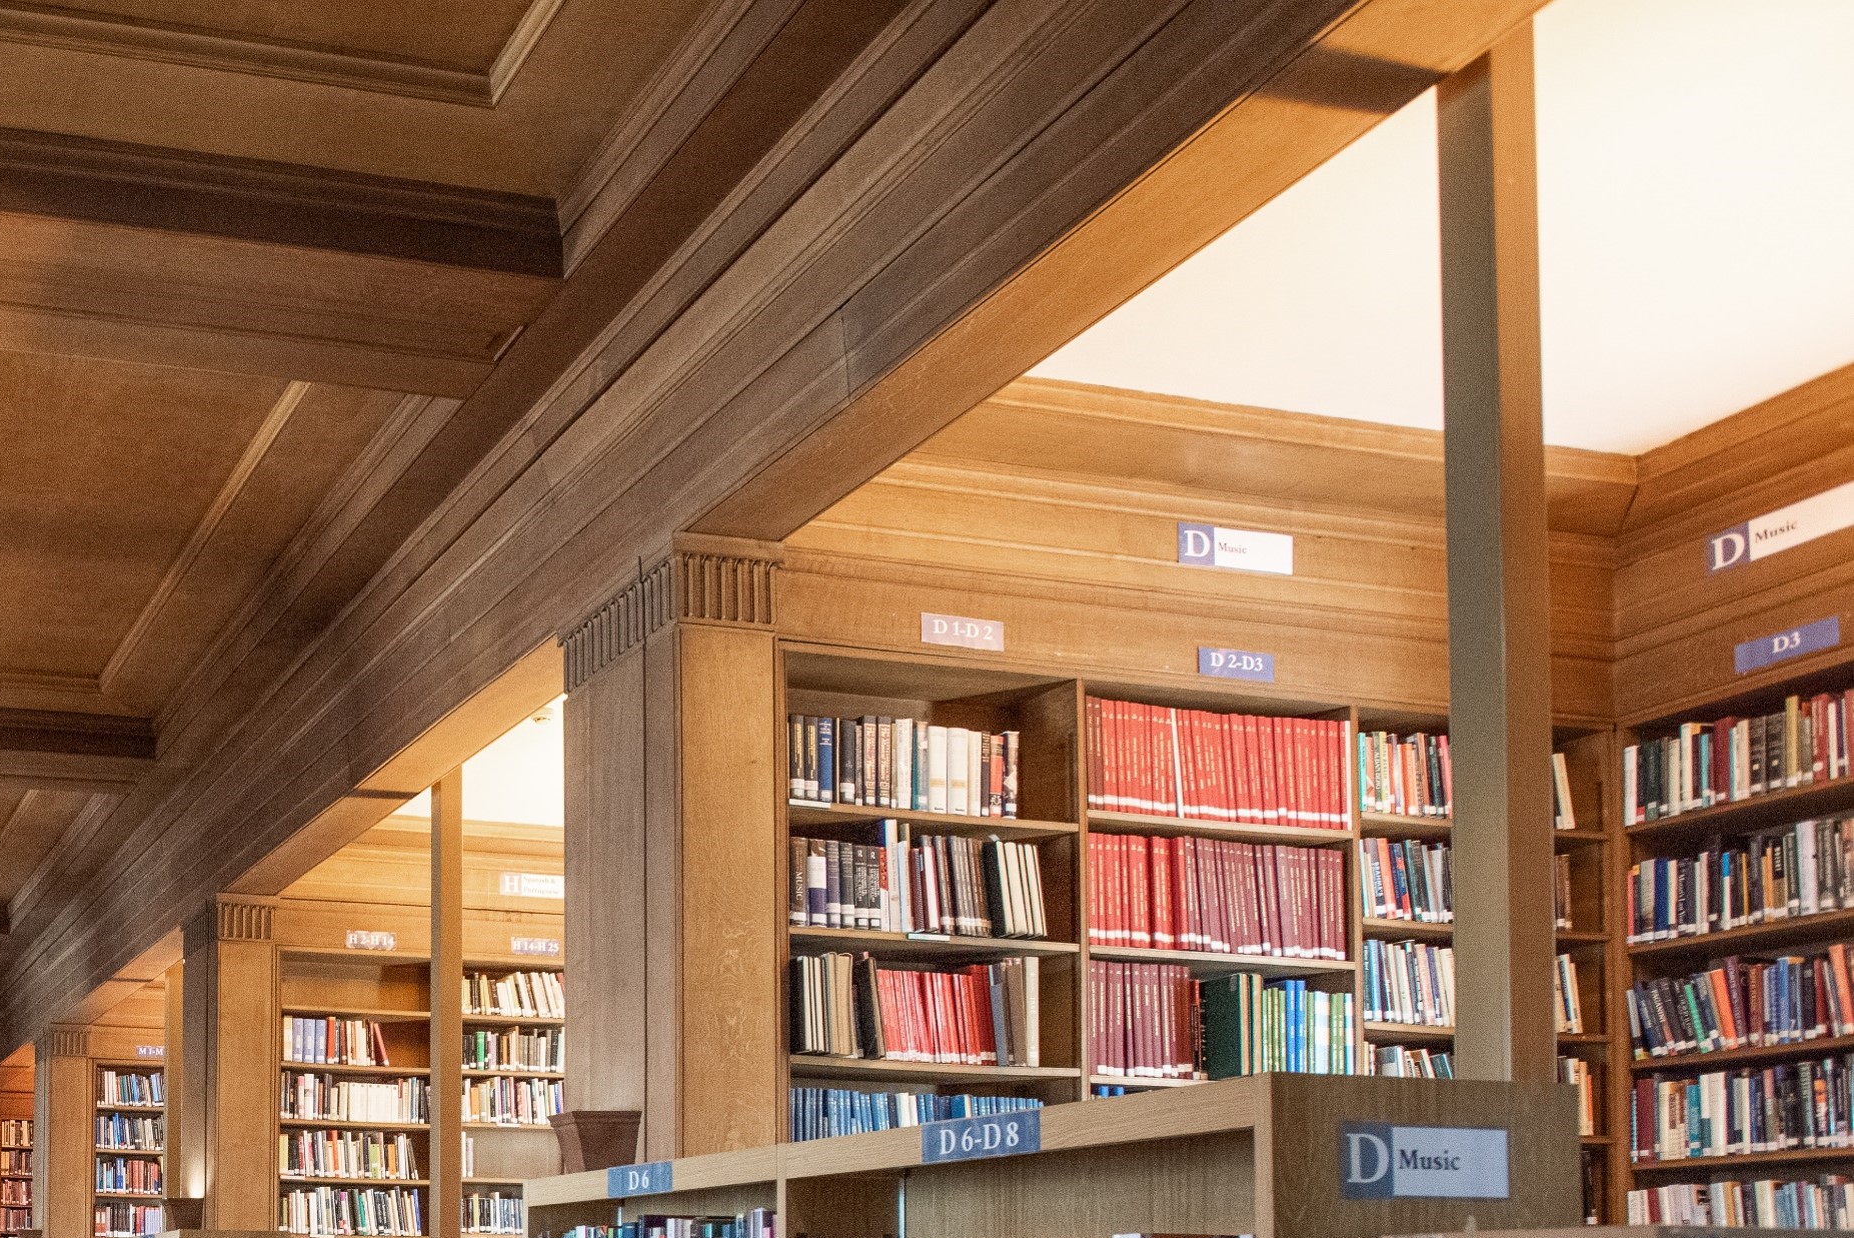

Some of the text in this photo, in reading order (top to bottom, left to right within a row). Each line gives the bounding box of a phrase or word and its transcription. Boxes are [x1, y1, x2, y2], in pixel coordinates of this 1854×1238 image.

[1184, 530, 1248, 558] D Music
[1711, 521, 1798, 571] D Music
[934, 619, 948, 635] D
[982, 626, 993, 641] 2
[1772, 632, 1801, 654] D3
[1210, 652, 1263, 672] D 2-D3
[504, 875, 519, 893] H
[349, 934, 358, 944] H
[512, 941, 522, 950] H
[940, 1129, 956, 1155] D
[1347, 1133, 1462, 1184] D Music
